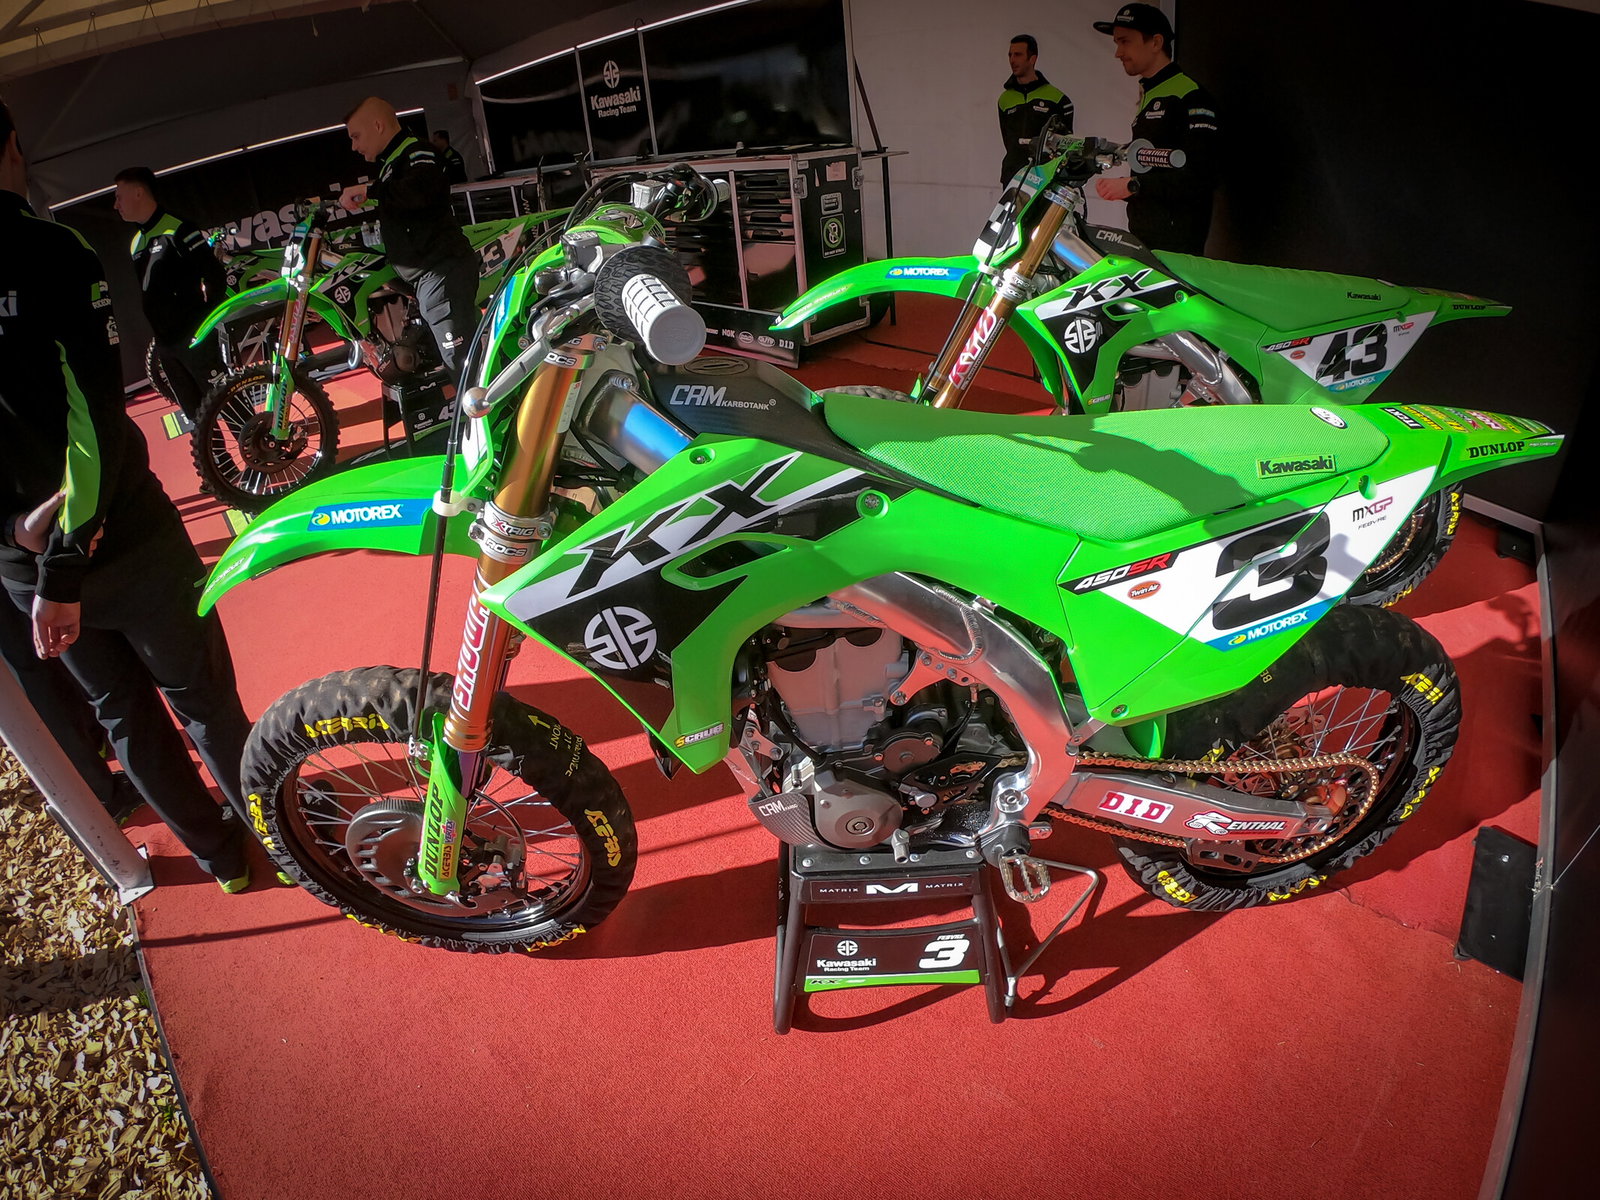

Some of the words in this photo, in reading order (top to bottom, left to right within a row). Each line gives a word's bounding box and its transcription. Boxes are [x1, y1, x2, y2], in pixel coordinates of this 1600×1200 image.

[590, 85, 641, 110] Kawasaki
[598, 107, 619, 118] Racing
[619, 104, 637, 114] Team
[1096, 230, 1122, 243] CRM
[904, 267, 950, 276] MOTOREX
[1062, 268, 1153, 312] KX
[1347, 291, 1381, 301] Kawasaki
[544, 352, 577, 366] OCS
[949, 306, 997, 389] KYB
[1315, 322, 1388, 383] 43
[1345, 375, 1377, 390] MOTOREX
[669, 384, 727, 407] CRM
[1468, 441, 1525, 459] DUNLOP
[1260, 455, 1334, 476] Kawasaki
[331, 503, 403, 524] MOTOREX
[1352, 496, 1393, 522] MXGP
[565, 453, 801, 602] KX
[484, 538, 528, 557] ROCS
[1073, 553, 1172, 591] 450SR
[1212, 511, 1331, 631] 3
[1247, 610, 1309, 641] MOTOREX
[758, 799, 786, 817] CRM
[425, 782, 444, 880] DUNLOP
[442, 845, 452, 877] ACERBIS
[816, 958, 877, 968] Kawasaki
[918, 939, 970, 969] 3
